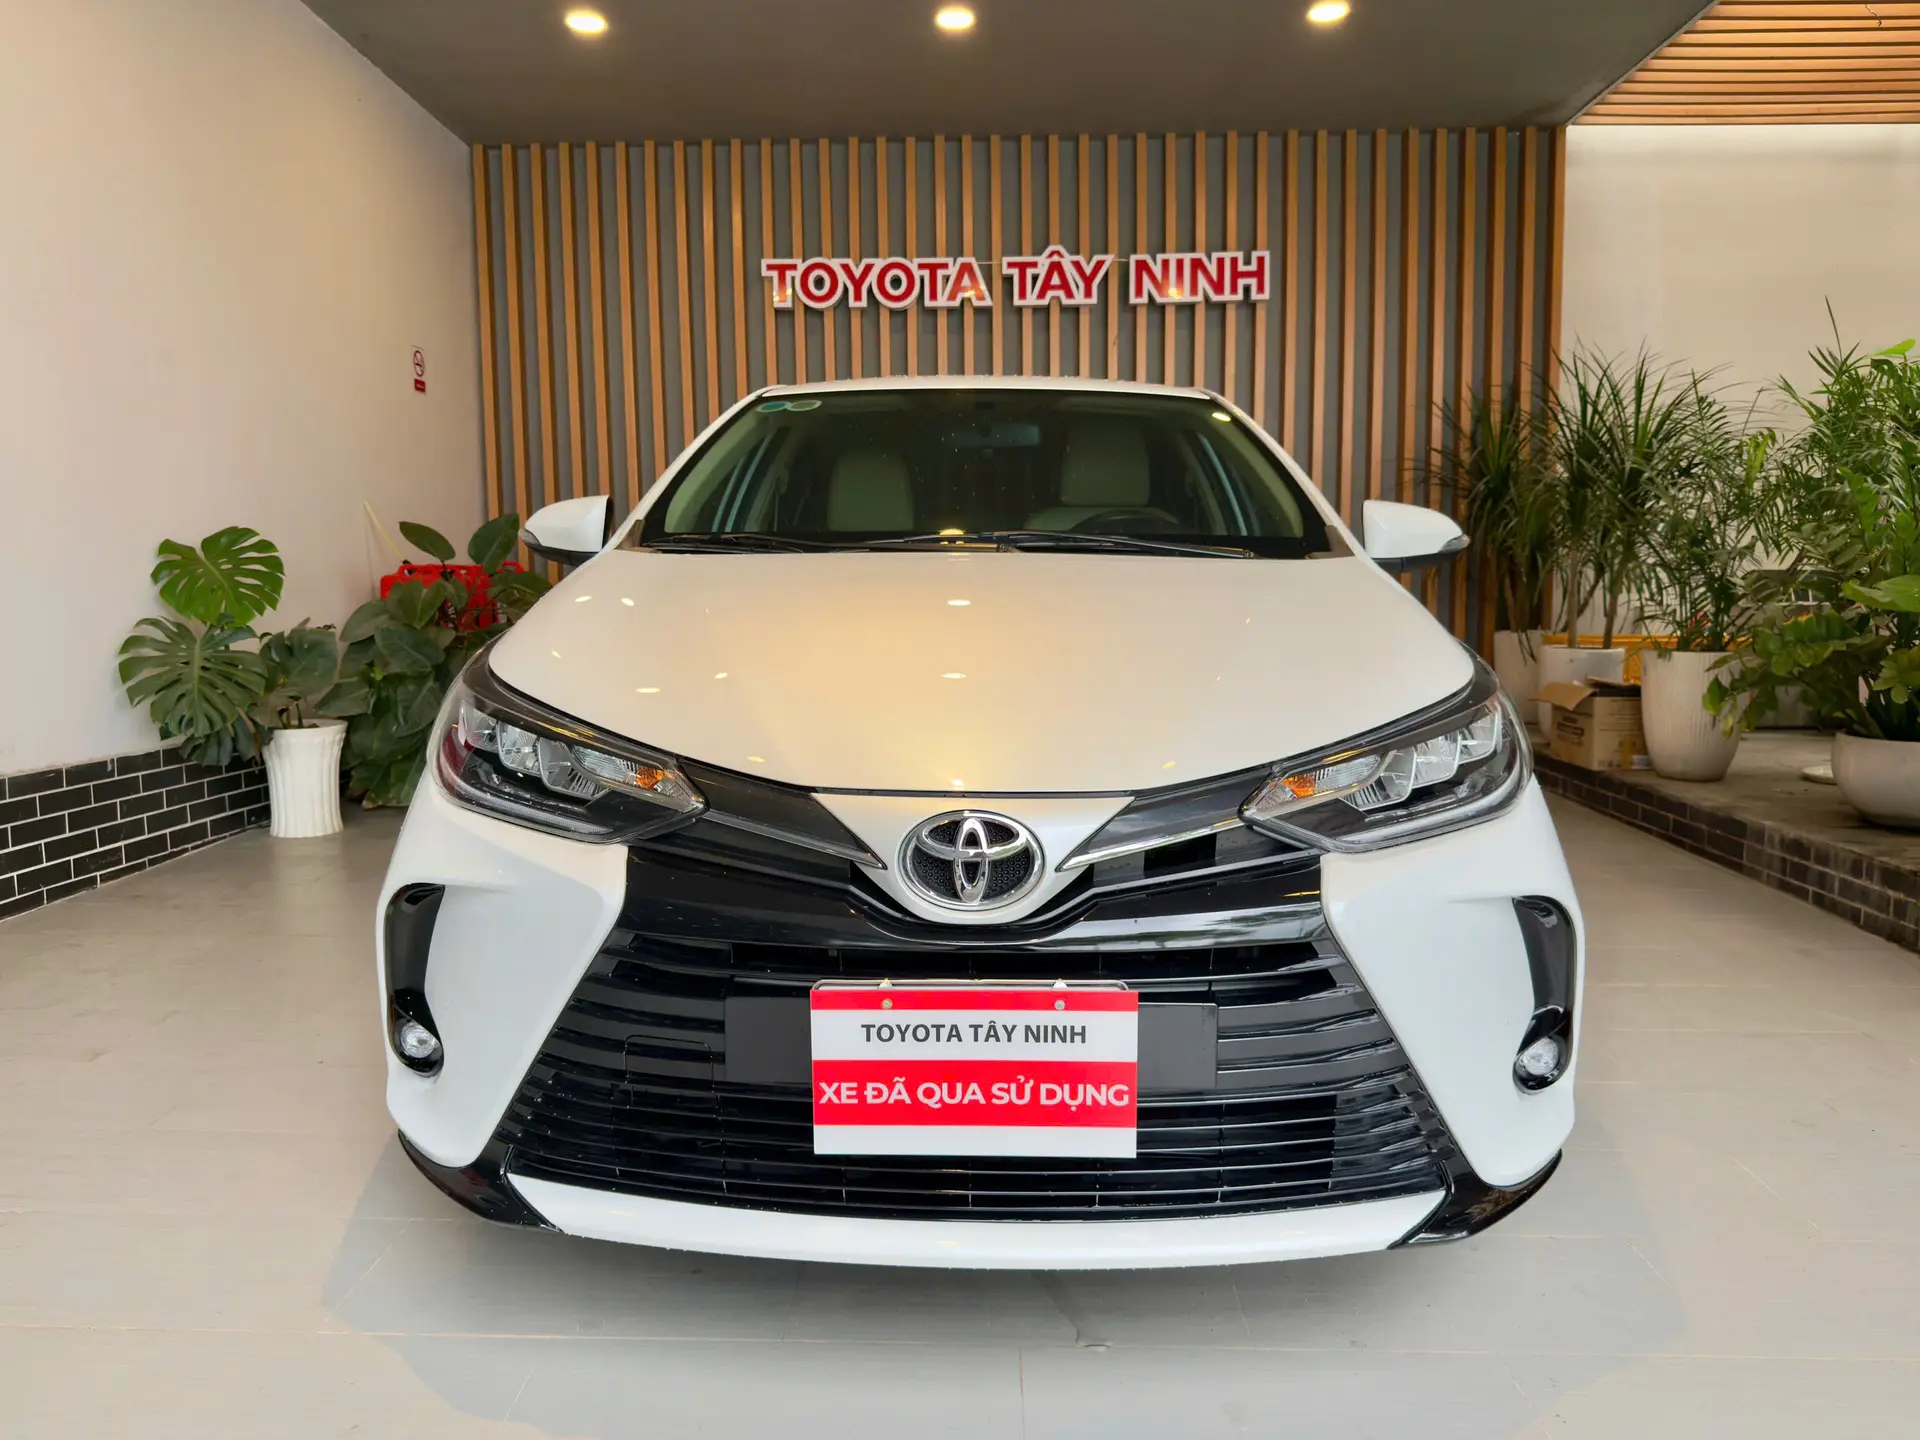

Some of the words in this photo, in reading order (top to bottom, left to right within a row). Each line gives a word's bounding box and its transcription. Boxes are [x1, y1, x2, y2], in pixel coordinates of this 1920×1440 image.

[764, 260, 990, 307] TOYOTA
[1004, 247, 1110, 305] TÂY
[1133, 253, 1268, 302] NINH
[861, 1023, 962, 1043] TOYOTA
[969, 1020, 1017, 1043] TÂY
[1024, 1024, 1086, 1044] NINH
[819, 1082, 858, 1104] XE
[864, 1077, 911, 1104] ĐÃ
[917, 1082, 985, 1109] QUA
[991, 1076, 1033, 1105] SỬ
[1040, 1084, 1129, 1111] DỤNG
